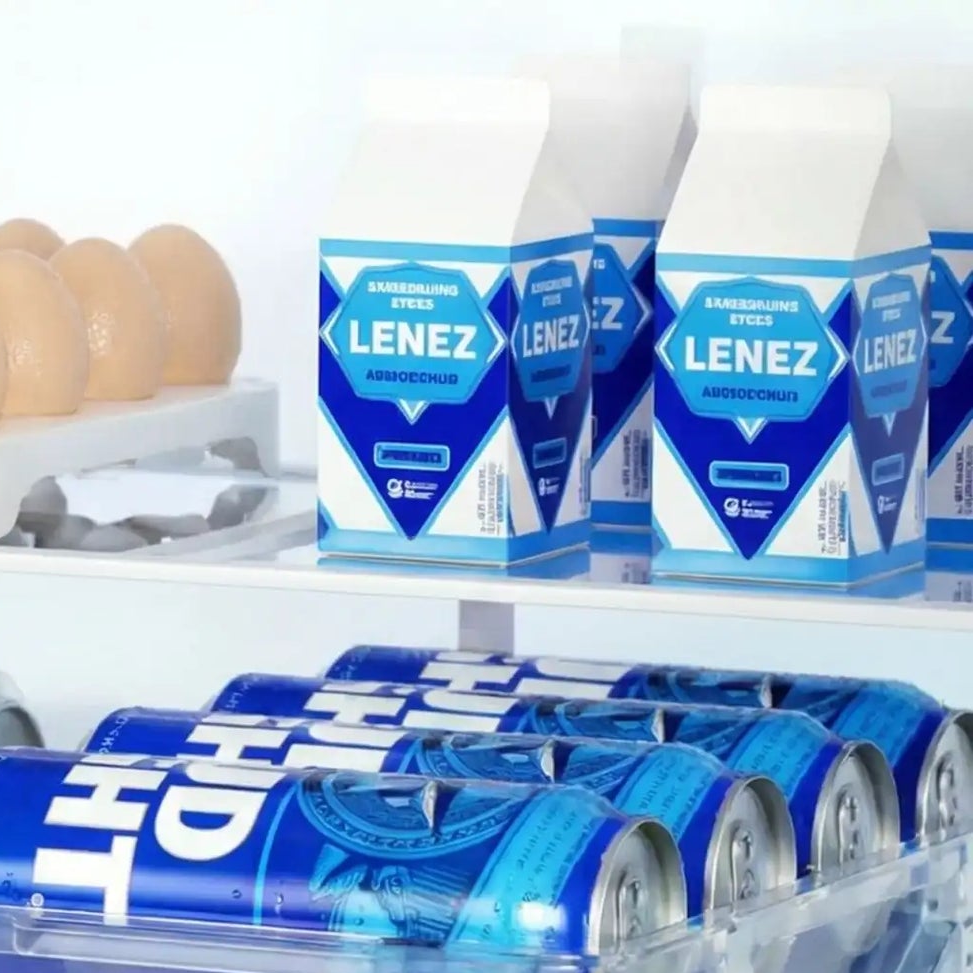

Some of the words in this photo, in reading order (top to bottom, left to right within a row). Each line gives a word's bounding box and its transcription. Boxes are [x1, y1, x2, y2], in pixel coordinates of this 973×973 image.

[349, 319, 477, 360] LENEZ
[522, 314, 580, 358] LENEZ
[685, 336, 818, 377] LENEZ
[864, 328, 917, 374] LENEZ
